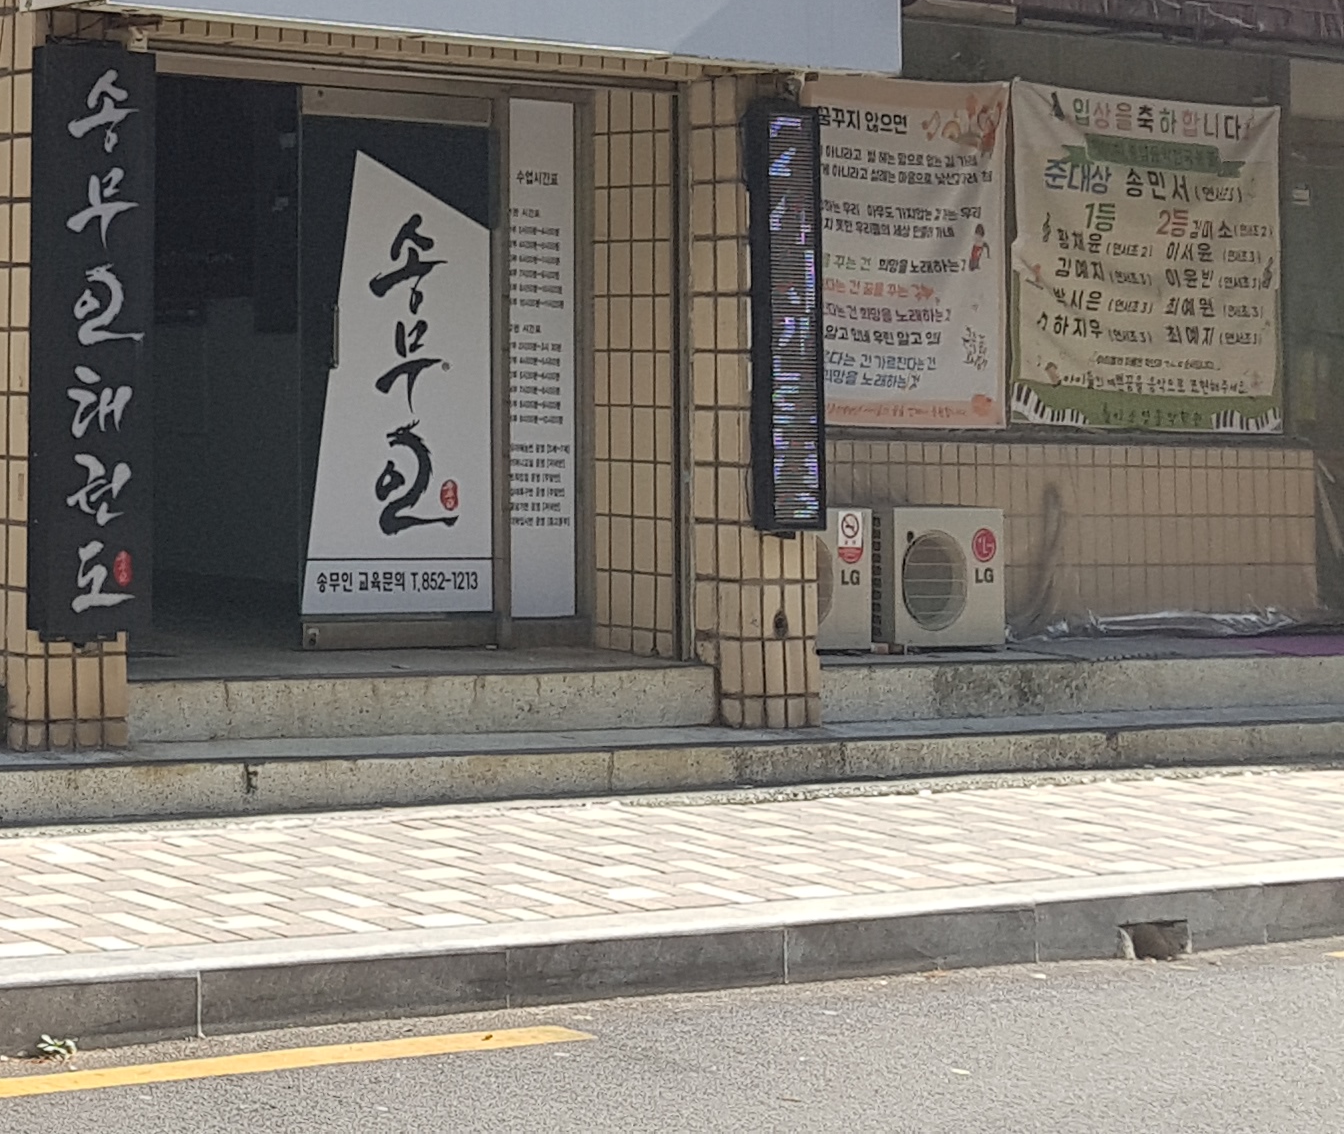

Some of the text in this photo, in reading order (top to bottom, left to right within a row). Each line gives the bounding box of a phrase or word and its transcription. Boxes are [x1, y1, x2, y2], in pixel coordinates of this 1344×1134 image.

[864, 110, 908, 135] 않으면
[825, 145, 862, 161] 아니라고
[515, 169, 559, 187] 수업시간표
[831, 164, 868, 180] 아니라고
[1044, 159, 1190, 203] 준대상 송민서
[1084, 202, 1189, 238] 1등 2등
[1053, 314, 1103, 339] 하지우
[368, 213, 459, 536] 송무인
[316, 571, 354, 593] 송무인
[358, 570, 407, 594] 교육문의
[840, 569, 861, 586] LG
[974, 568, 995, 584] LG
